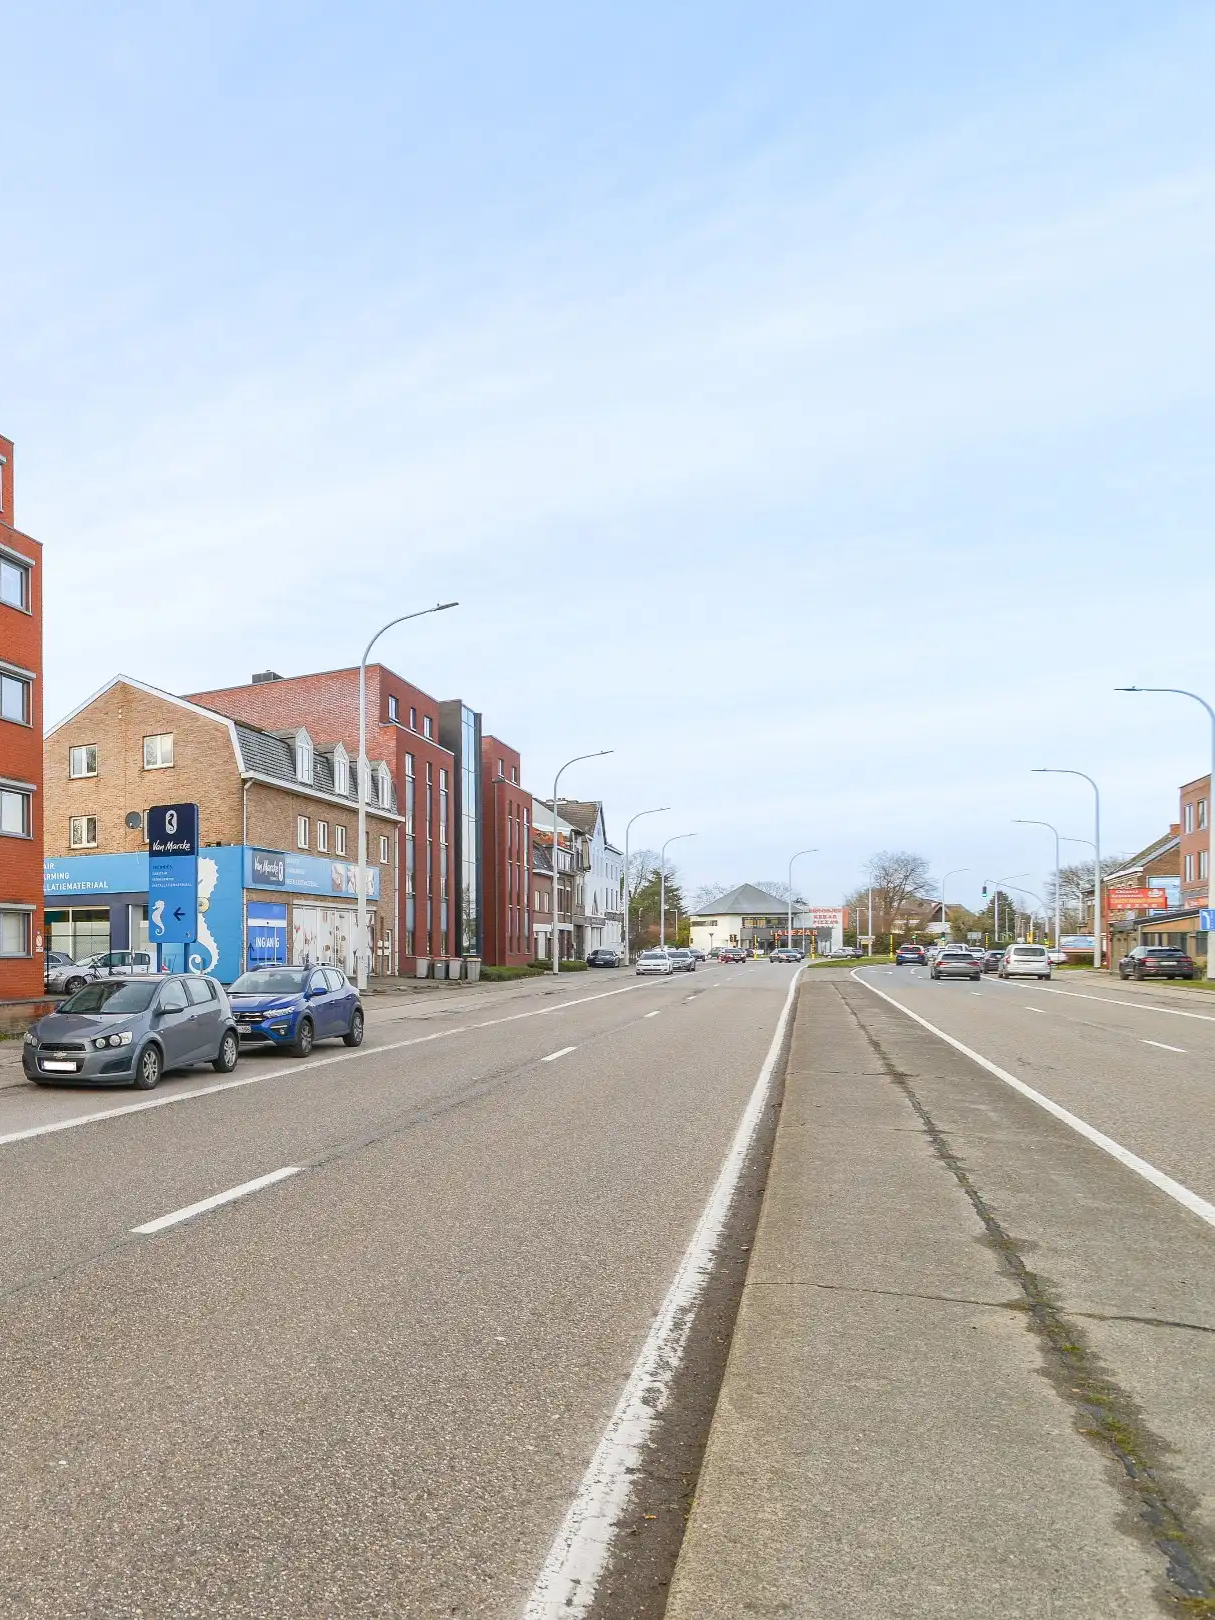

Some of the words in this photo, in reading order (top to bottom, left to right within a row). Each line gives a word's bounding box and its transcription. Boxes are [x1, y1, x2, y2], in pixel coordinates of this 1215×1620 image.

[152, 840, 165, 852] Van
[165, 840, 191, 852] Marcke
[254, 855, 263, 874] Van
[262, 859, 279, 877] Marcke
[255, 937, 280, 948] INGANG
